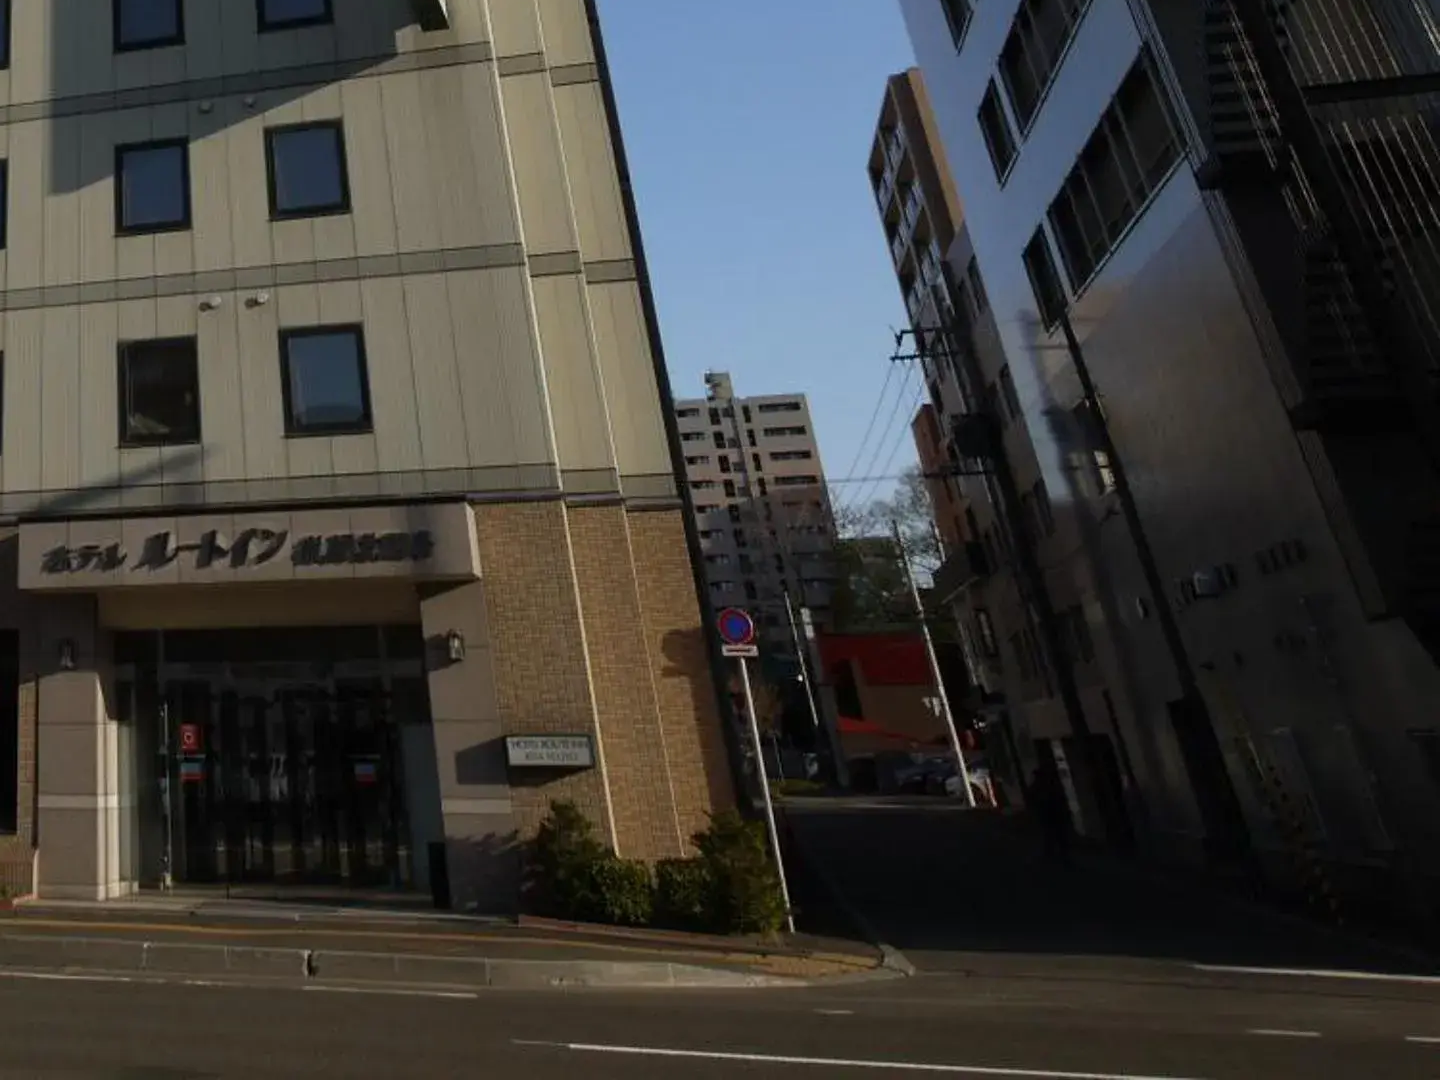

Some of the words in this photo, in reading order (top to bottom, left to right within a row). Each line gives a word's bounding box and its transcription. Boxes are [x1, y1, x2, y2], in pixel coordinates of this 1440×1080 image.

[41, 542, 127, 573] ホテル
[131, 528, 288, 571] ルートイン
